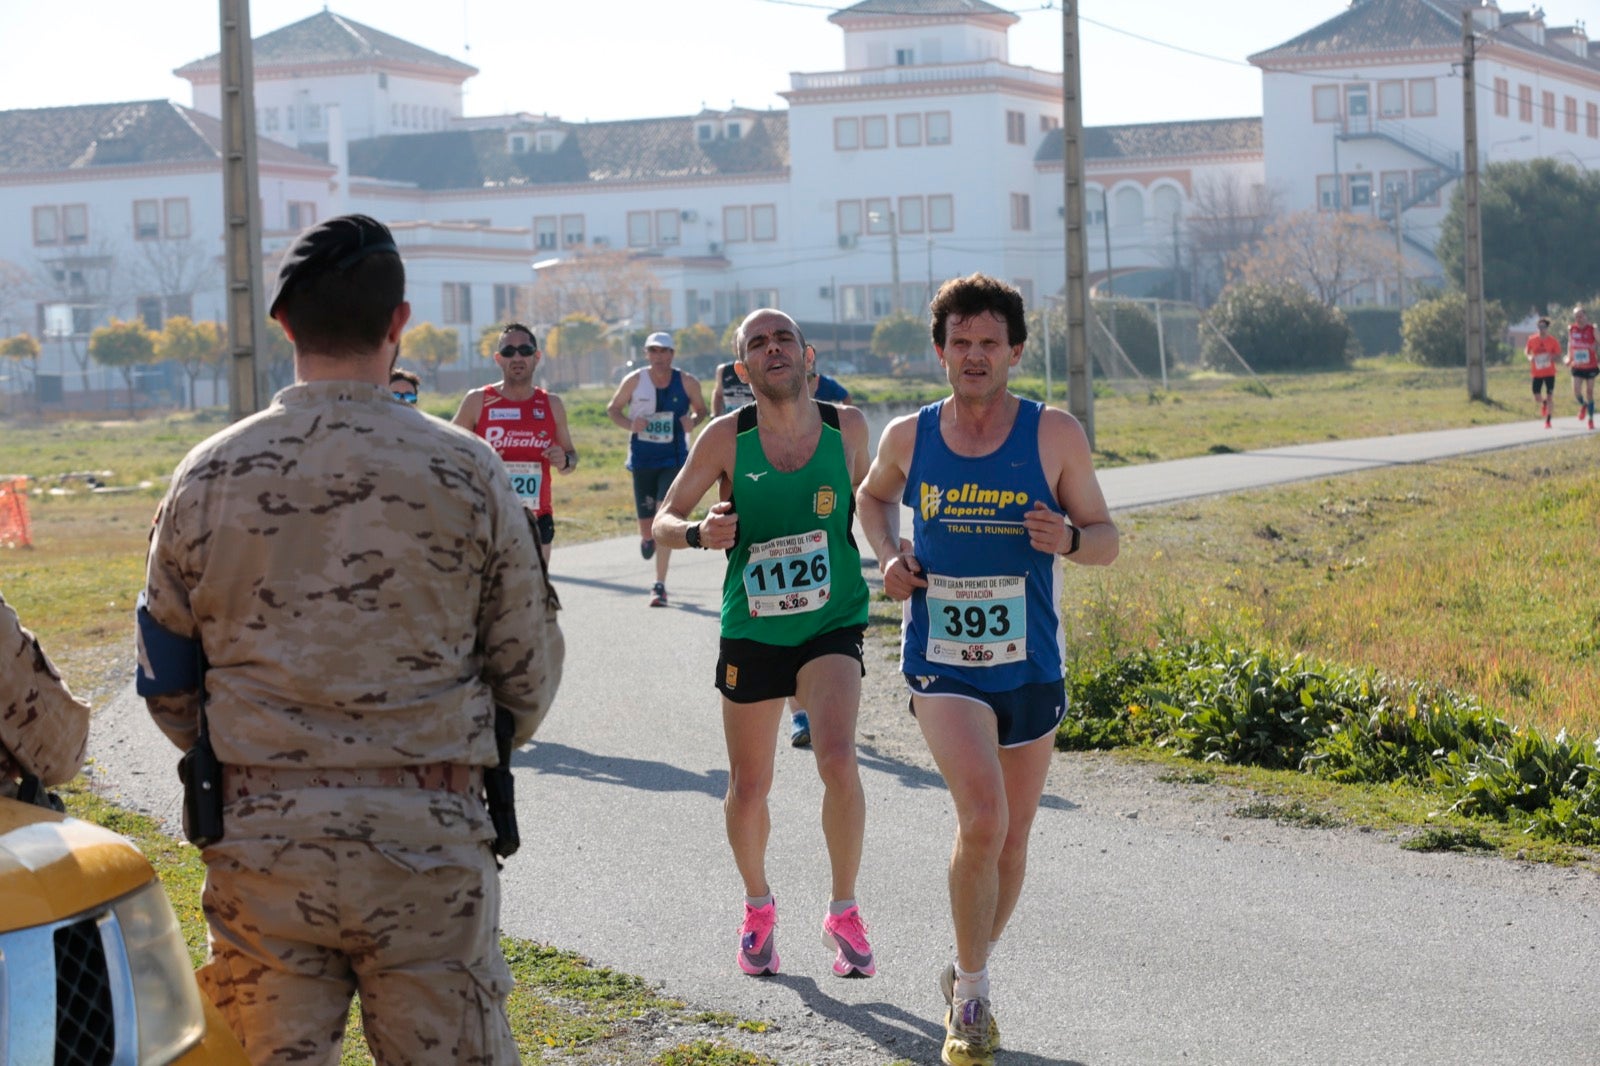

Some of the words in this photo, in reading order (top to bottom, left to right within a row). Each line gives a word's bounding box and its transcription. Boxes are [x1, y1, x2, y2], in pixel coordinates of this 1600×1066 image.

[485, 426, 551, 448] Polisalud
[946, 483, 1028, 509] olimpo
[944, 504, 996, 517] deportes
[947, 525, 973, 534] TRAIL
[975, 525, 982, 534] &
[984, 526, 1025, 536] RUNNING
[750, 554, 828, 591] 1126
[947, 580, 964, 589] GRAN
[965, 580, 988, 589] PREMIO
[989, 579, 997, 588] DE
[998, 578, 1019, 588] FONDO
[943, 604, 1010, 638] 393
